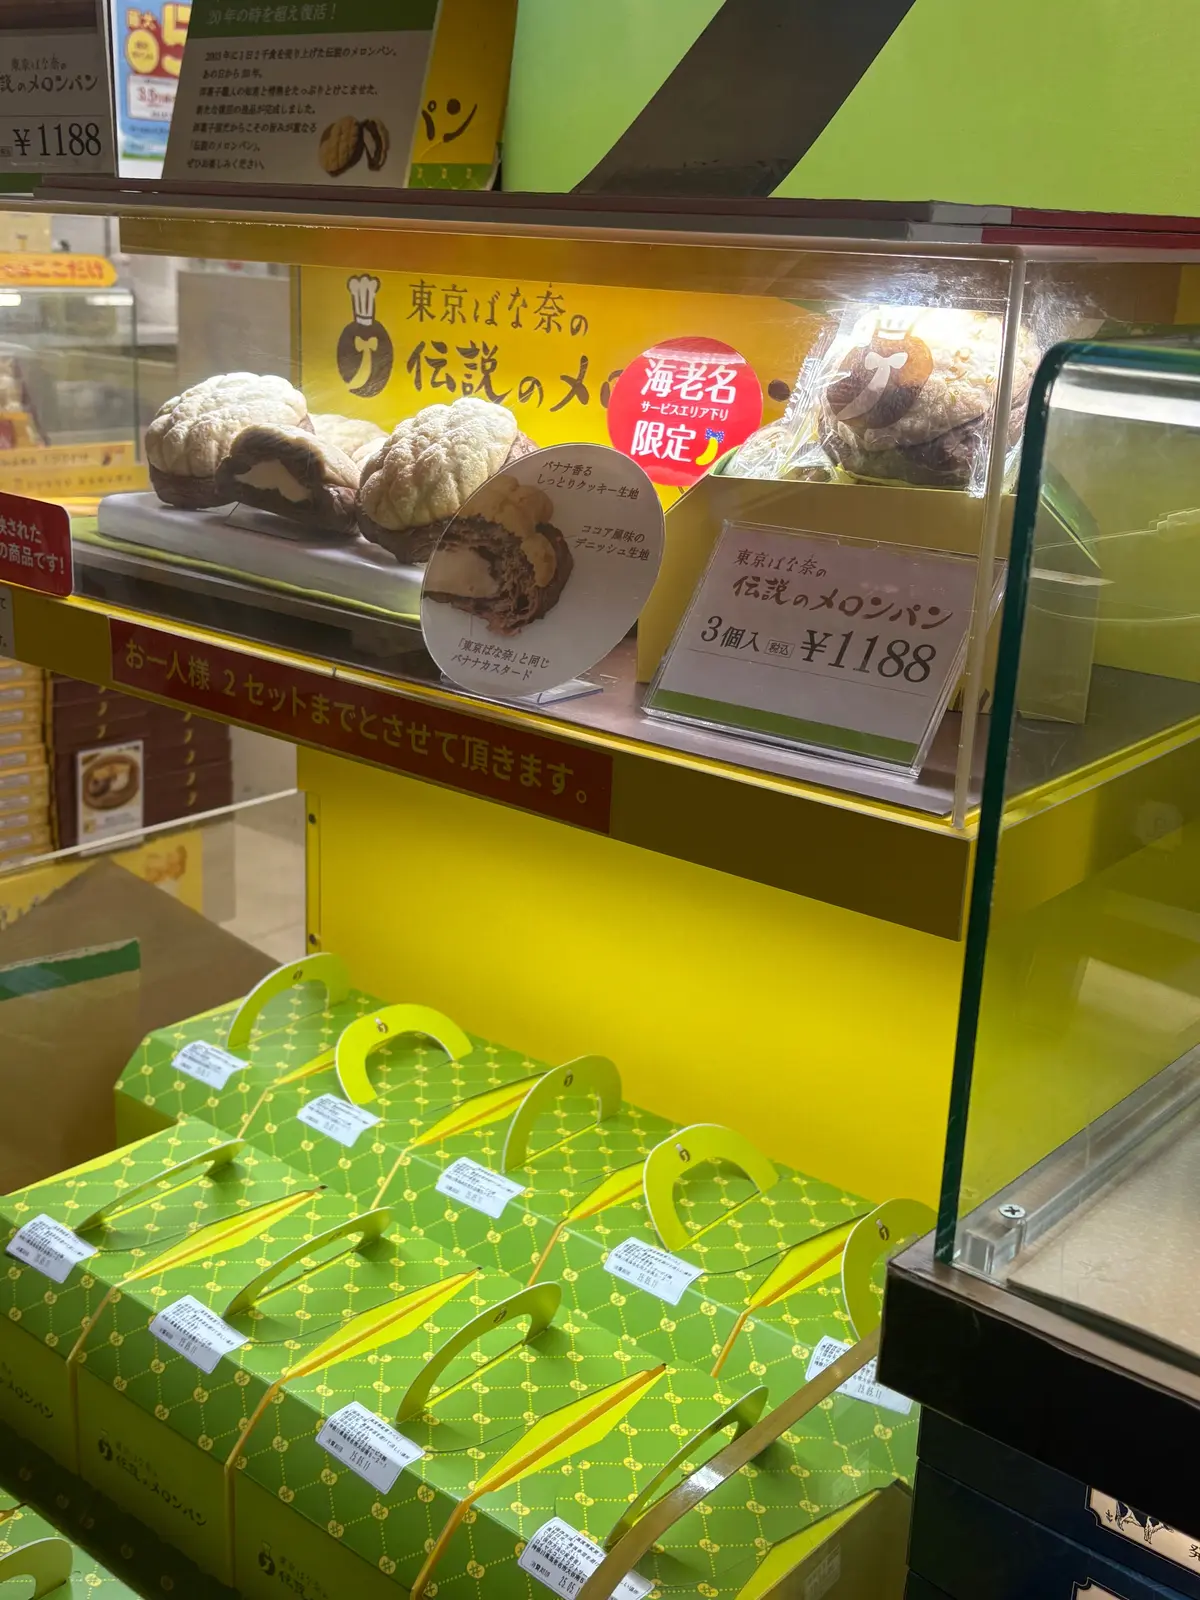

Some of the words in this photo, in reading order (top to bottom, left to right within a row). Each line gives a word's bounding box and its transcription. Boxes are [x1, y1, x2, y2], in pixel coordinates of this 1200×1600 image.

[12, 122, 102, 156] ¥1188
[406, 278, 589, 336] 東京ばな奈の
[640, 359, 737, 404] 海老名
[641, 401, 729, 421] サービスエリア下り
[630, 420, 696, 462] 限定
[542, 460, 593, 476] バナナ香る
[537, 474, 640, 500] しっとりクッキー生地
[581, 525, 645, 543] ココア風味の
[574, 538, 650, 561] デニッシュ生地
[732, 549, 828, 577] 東京ばな奈の
[732, 575, 954, 629] 伝説のメロンパン
[457, 638, 550, 668] 「東京ばな奈」と同じ
[701, 615, 760, 652] 3個入
[767, 640, 792, 657] 税込
[801, 629, 936, 683] ¥1188
[450, 655, 532, 680] バナナカスタード
